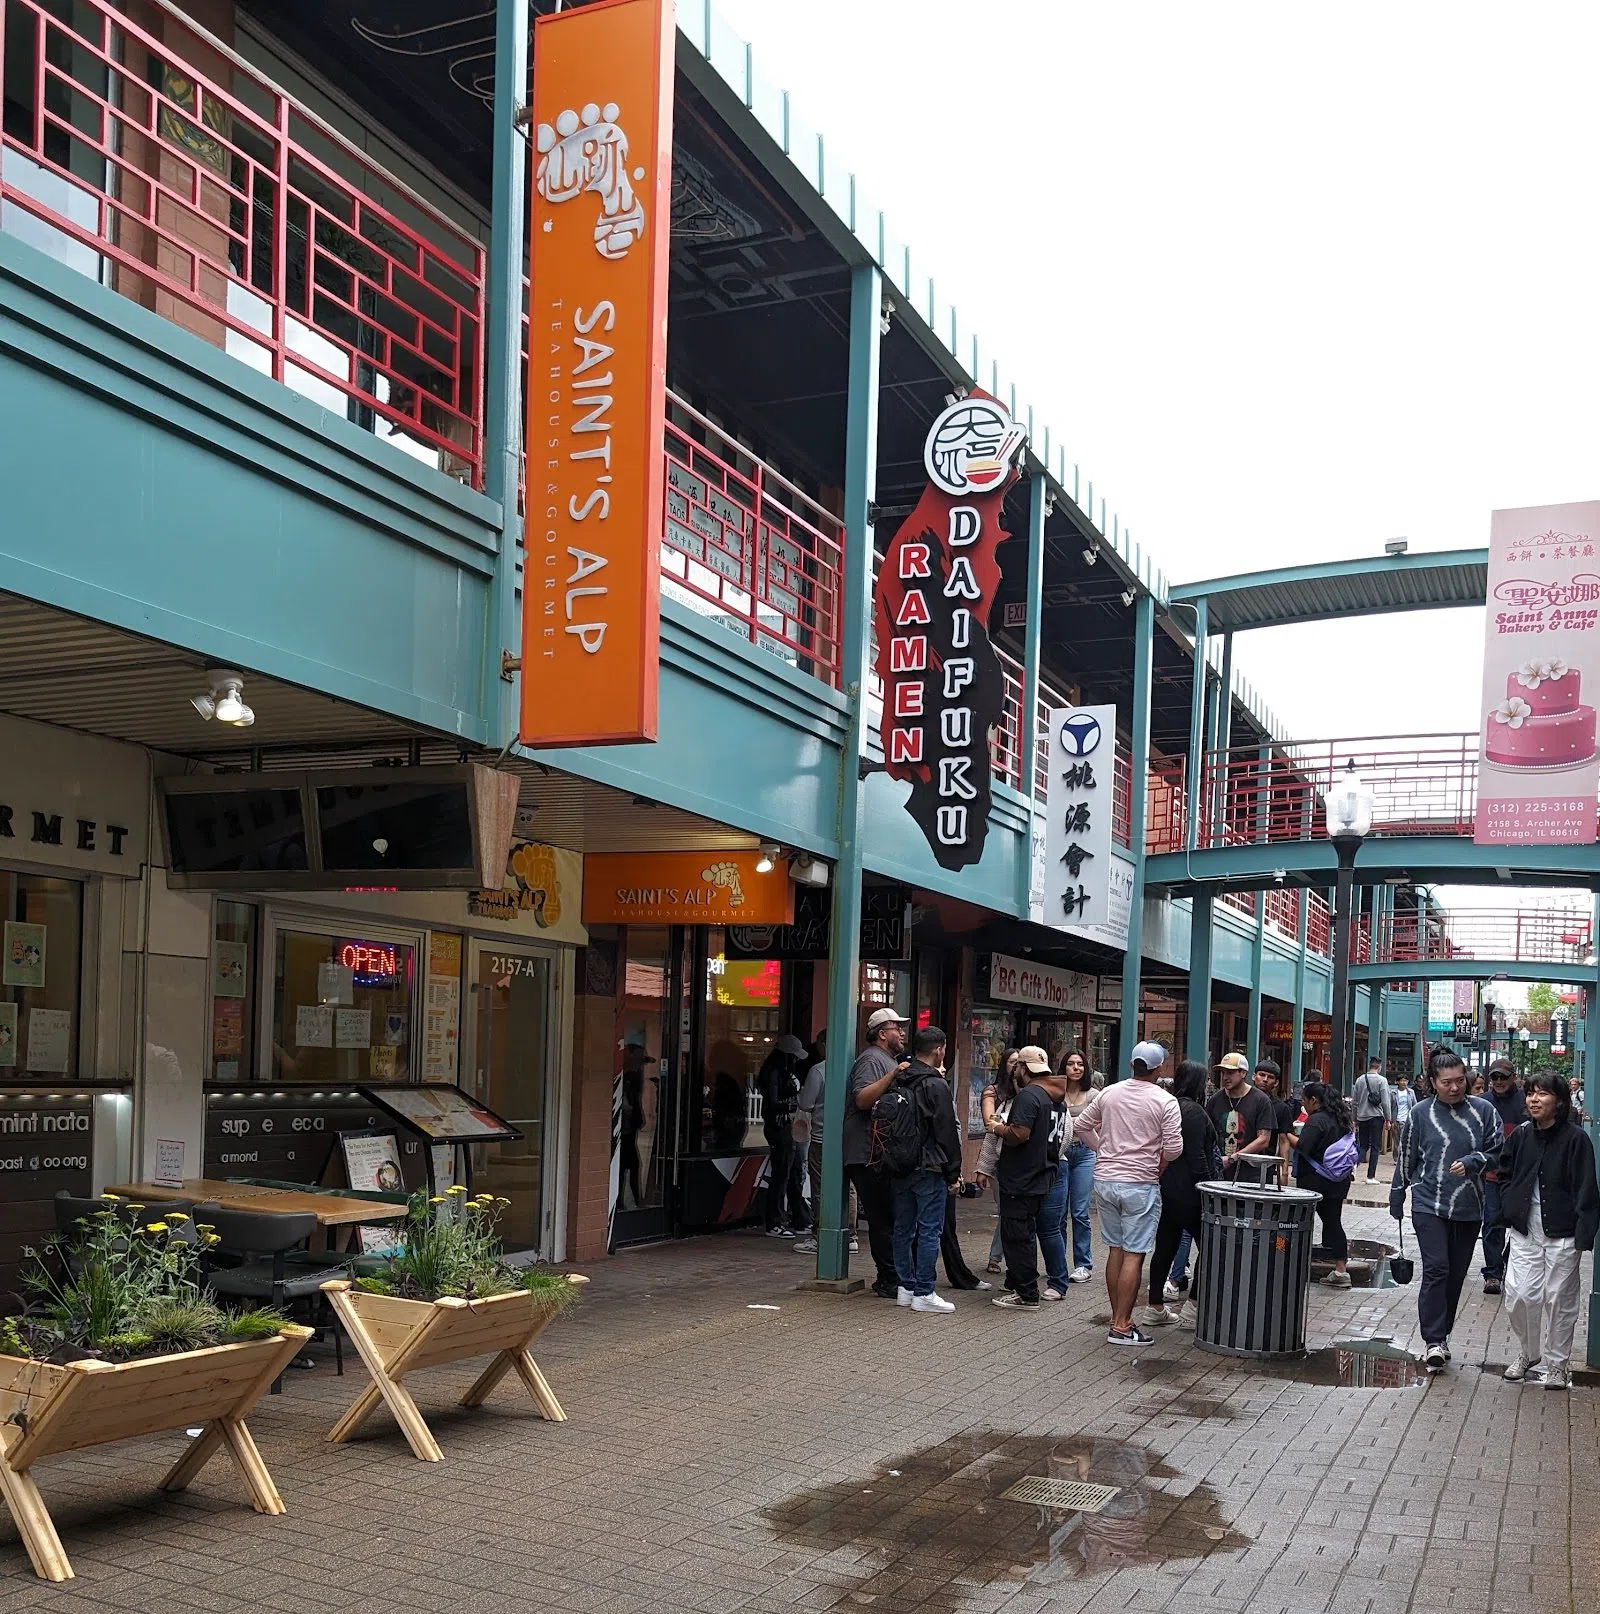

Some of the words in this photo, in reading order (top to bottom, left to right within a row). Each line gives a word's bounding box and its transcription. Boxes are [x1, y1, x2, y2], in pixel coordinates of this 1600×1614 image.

[548, 299, 563, 467] TEAHOUSE
[570, 299, 615, 522] SAINT'S
[543, 505, 560, 660] GOURMET
[565, 544, 610, 654] ALP
[1007, 604, 1024, 620] EXI
[1495, 610, 1543, 625] Saint
[1549, 609, 1598, 621] Anna
[1498, 623, 1545, 634] Bakery
[1548, 621, 1561, 631] &
[1564, 619, 1595, 631] Cafe
[890, 543, 932, 764] RAMEN
[937, 505, 982, 847] DAIFUKU
[1487, 803, 1519, 815] (312)
[1525, 802, 1584, 813] 225-3168
[1487, 820, 1510, 828] 2158
[1526, 819, 1560, 828] Archer
[1564, 819, 1583, 827] Ave
[1490, 829, 1534, 839] Chicago,
[1550, 828, 1579, 836] 60616
[1060, 760, 1097, 918] 桃源會計
[616, 888, 679, 906] SAINT'S
[684, 889, 717, 906] ALP
[342, 944, 395, 976] OPEN
[491, 956, 535, 978] 2157-A
[999, 966, 1017, 994] BG
[1020, 971, 1042, 999] Gift
[1044, 976, 1069, 1004] Shop
[43, 1111, 89, 1132] nata
